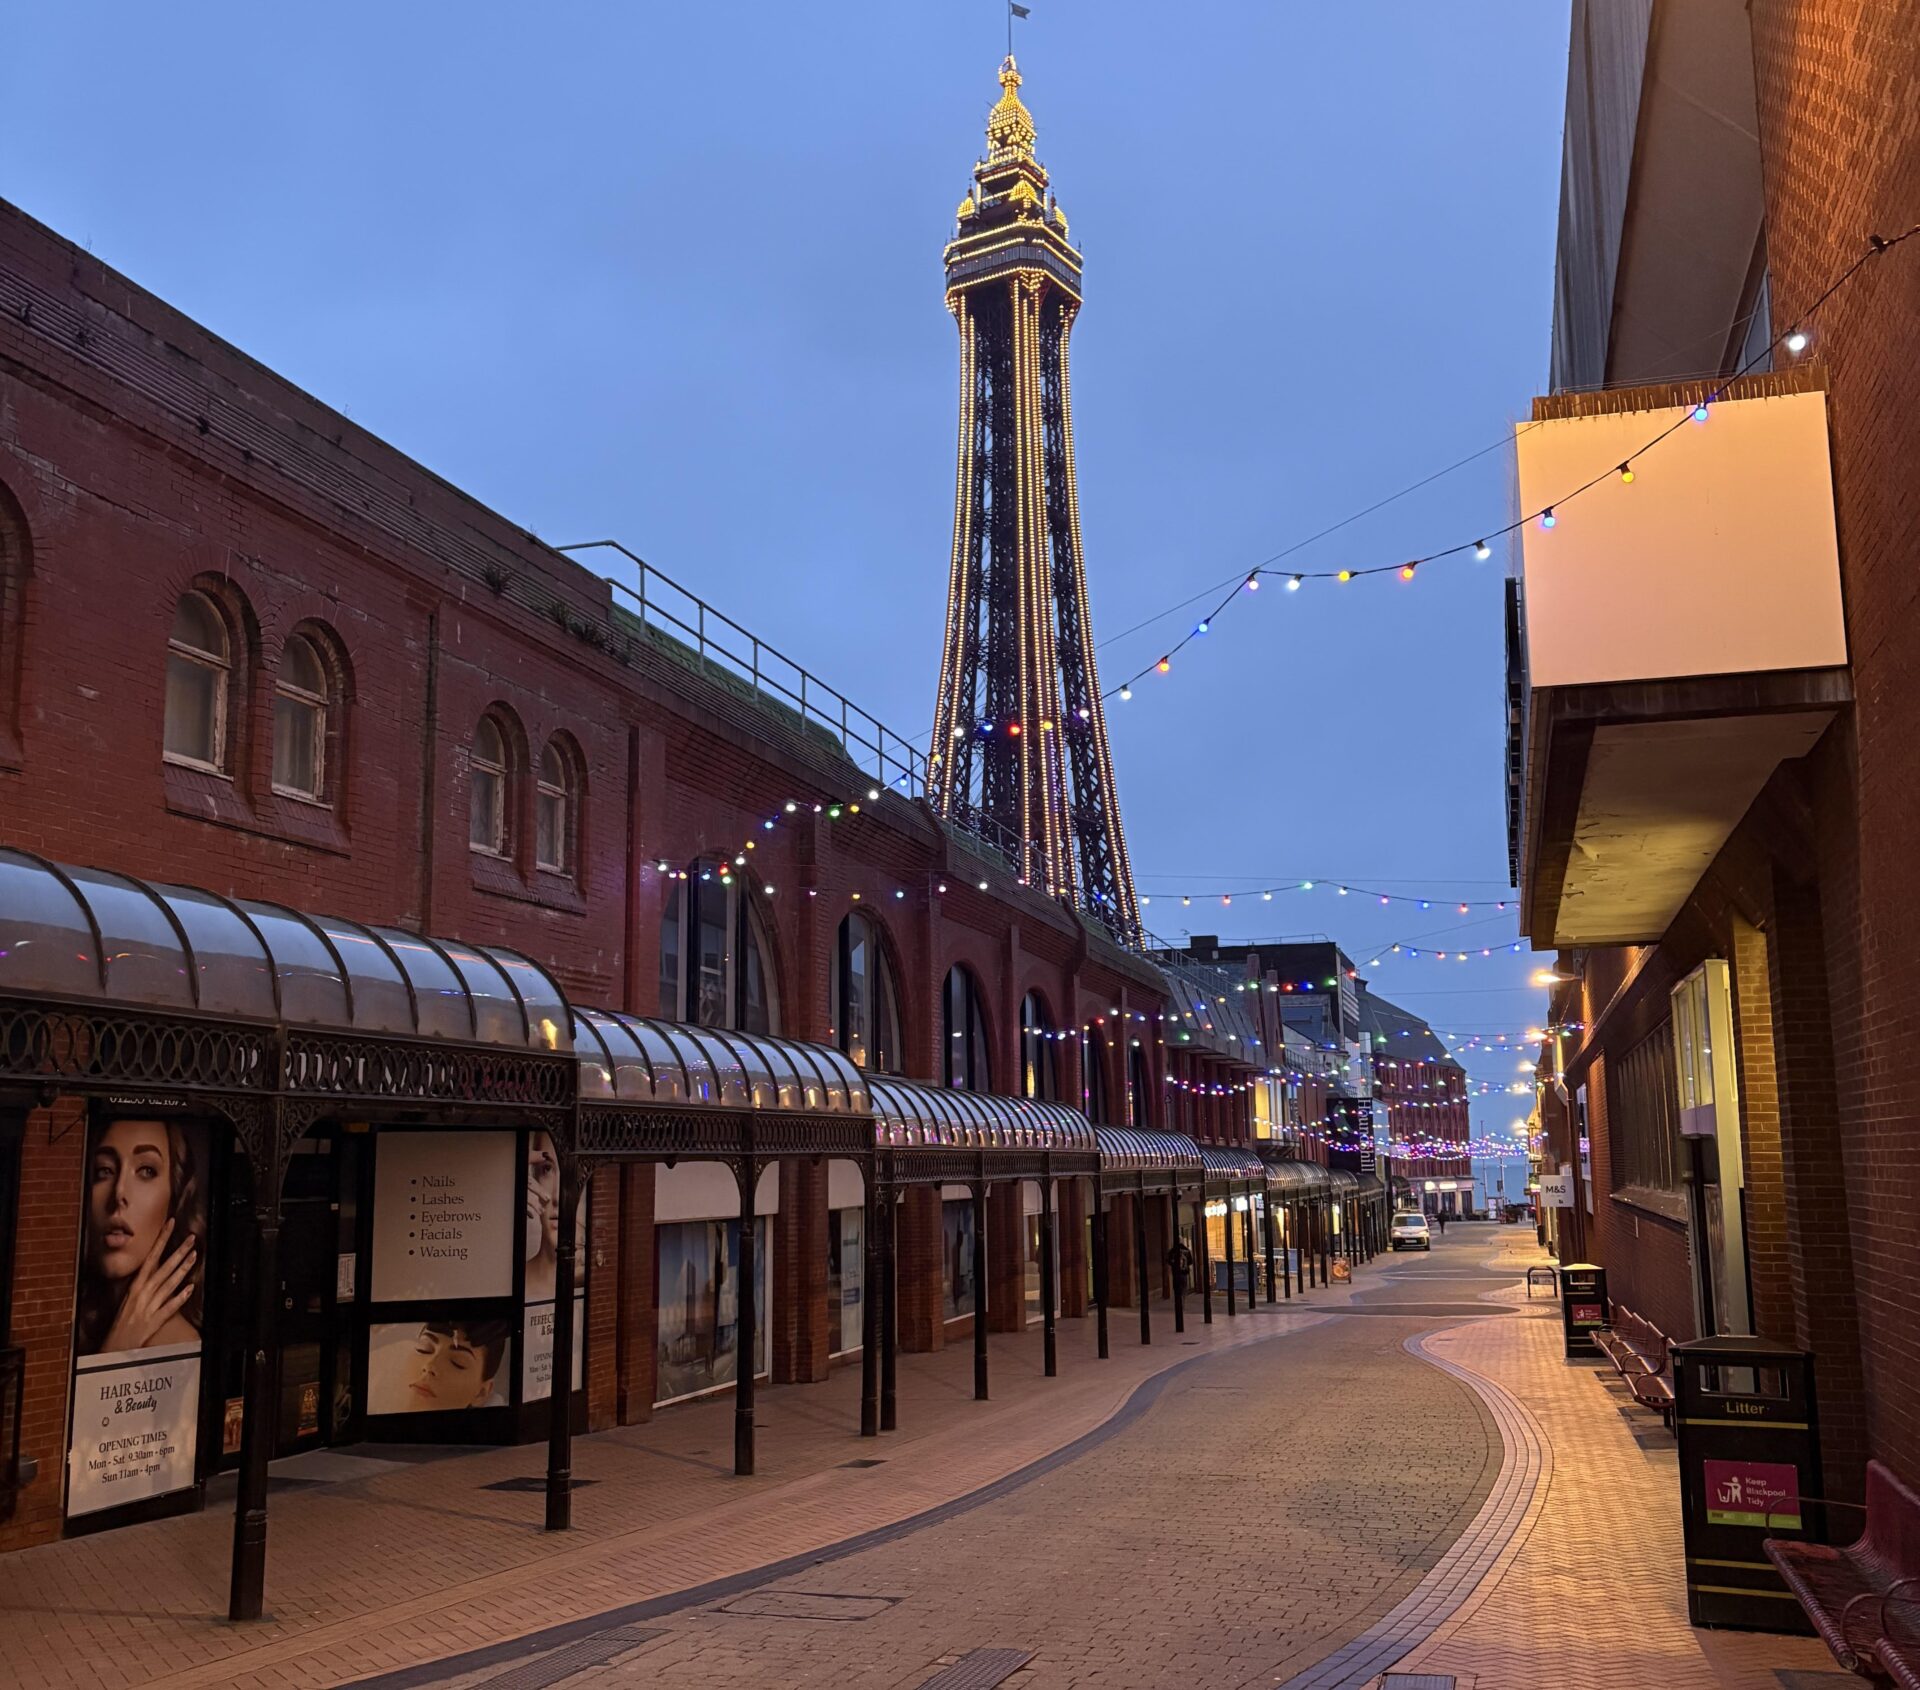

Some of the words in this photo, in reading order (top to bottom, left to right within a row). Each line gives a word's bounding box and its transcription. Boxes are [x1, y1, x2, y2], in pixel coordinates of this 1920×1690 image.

[422, 1175, 456, 1187] Nails
[1545, 1185, 1566, 1193] M&S
[422, 1192, 465, 1205] Lashes
[421, 1210, 482, 1227] Eyebrows
[420, 1227, 463, 1240] Facials
[420, 1245, 469, 1260] Waxing
[100, 1382, 131, 1401] HAIR
[134, 1375, 173, 1395] SALON
[114, 1399, 123, 1414] &
[125, 1395, 158, 1413] Beauty
[1726, 1401, 1765, 1414] Litter
[98, 1436, 140, 1454] OPENING
[142, 1430, 168, 1443] TIMES
[88, 1459, 107, 1471] Mon
[113, 1455, 125, 1466] Sat
[159, 1445, 175, 1458] 6pm
[101, 1472, 118, 1483] Sun
[119, 1468, 139, 1480] 11am
[144, 1463, 161, 1476] 4pm
[1745, 1477, 1767, 1486] Keep
[1746, 1487, 1786, 1498] Blackpool
[1746, 1496, 1765, 1507] Tidy
